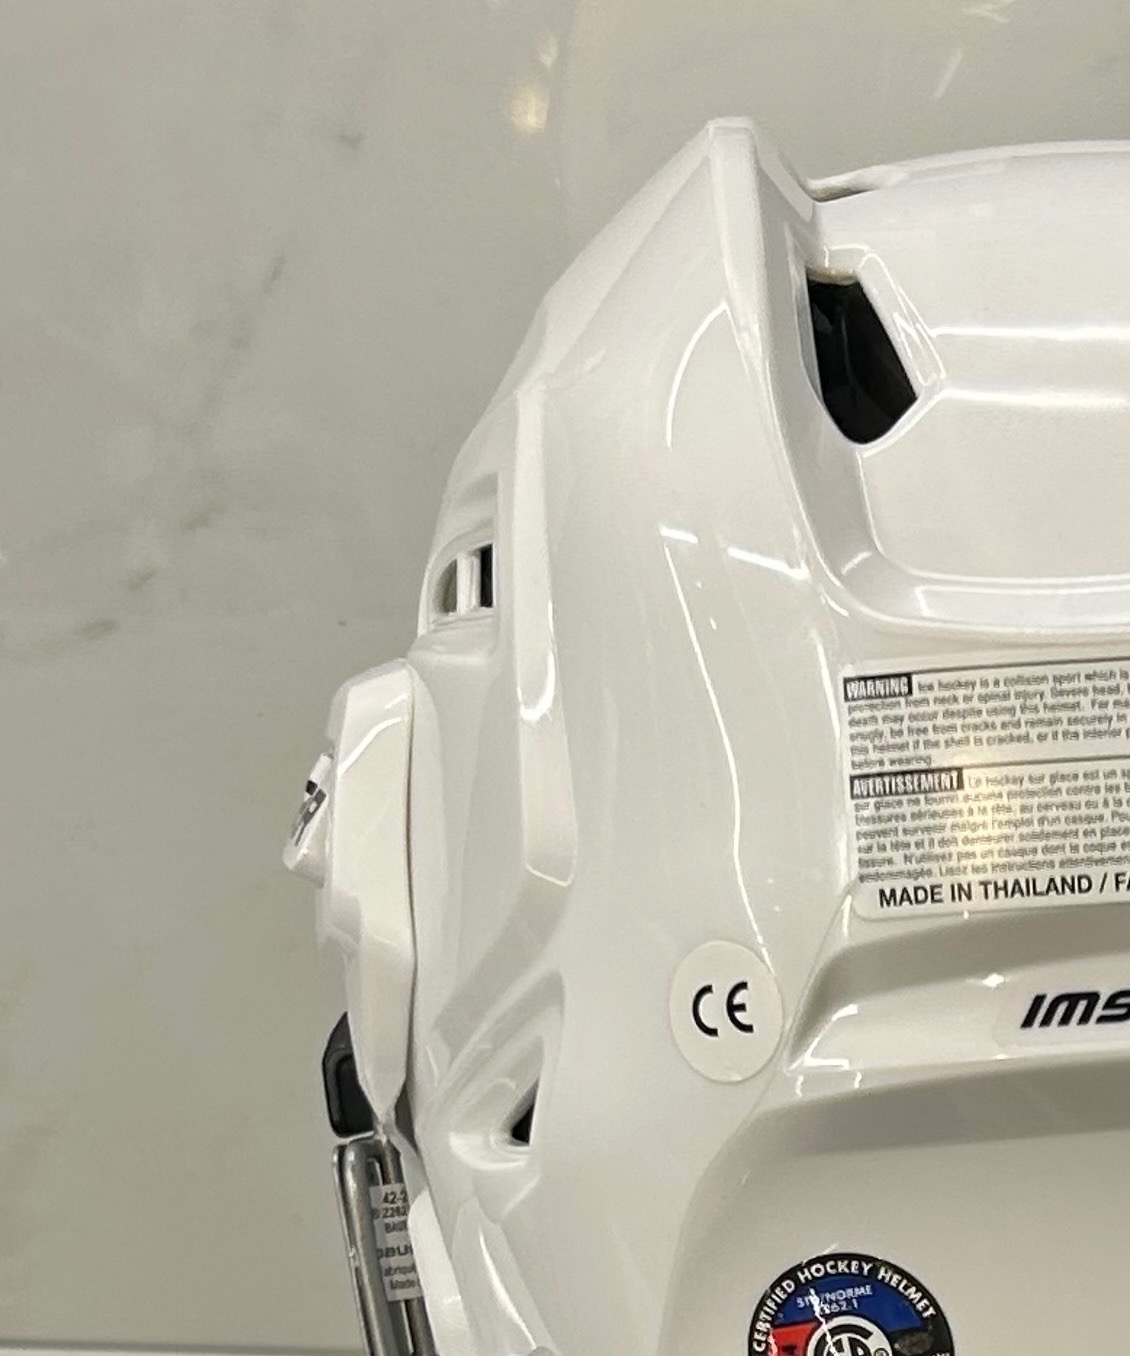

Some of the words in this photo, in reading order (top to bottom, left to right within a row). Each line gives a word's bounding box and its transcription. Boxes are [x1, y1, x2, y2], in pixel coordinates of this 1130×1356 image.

[846, 676, 909, 700] WARNING
[852, 770, 959, 798] AVERTISSEMENT
[878, 884, 944, 908] MADE
[950, 881, 973, 903] IN
[979, 872, 1093, 900] THAILAND
[692, 981, 754, 1037] CE
[752, 1279, 796, 1353] CERTIFIED
[797, 1260, 874, 1284] HOCKEY
[877, 1267, 936, 1319] HELMET
